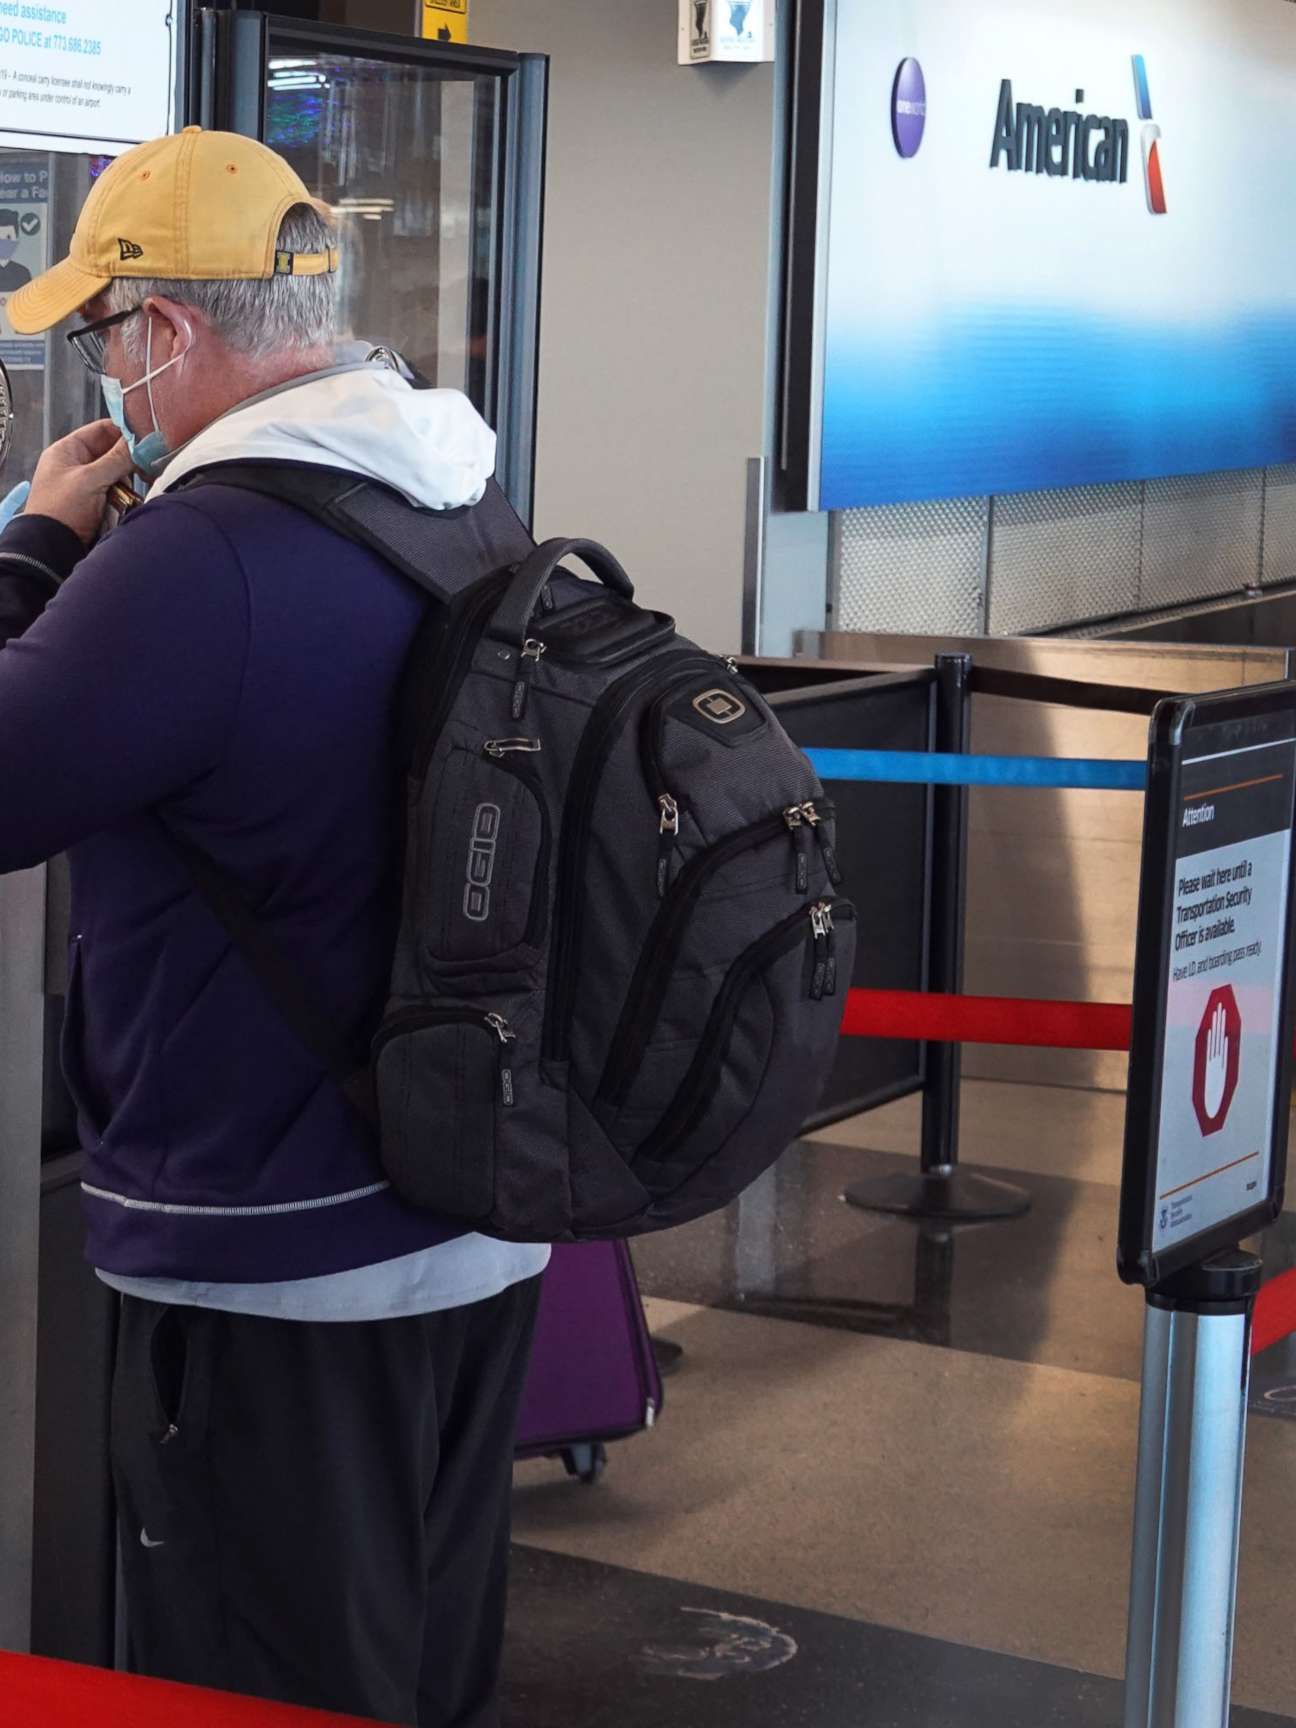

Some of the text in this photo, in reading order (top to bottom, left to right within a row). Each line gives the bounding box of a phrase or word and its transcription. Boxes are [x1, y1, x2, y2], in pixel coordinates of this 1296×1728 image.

[20, 4, 67, 25] assistance
[11, 27, 42, 49] POLICE
[44, 34, 51, 49] at
[989, 79, 1129, 184] American
[24, 171, 36, 184] to
[19, 189, 30, 199] a
[1182, 802, 1215, 828] Attention
[464, 803, 501, 921] OGIO
[1178, 858, 1253, 897] Please wait here until a
[1177, 885, 1253, 924] Transportation Security
[1174, 928, 1198, 952] Officer
[1198, 924, 1205, 945] is
[1172, 965, 1188, 982] Have
[1197, 956, 1208, 975] and
[1208, 948, 1233, 969] boarding
